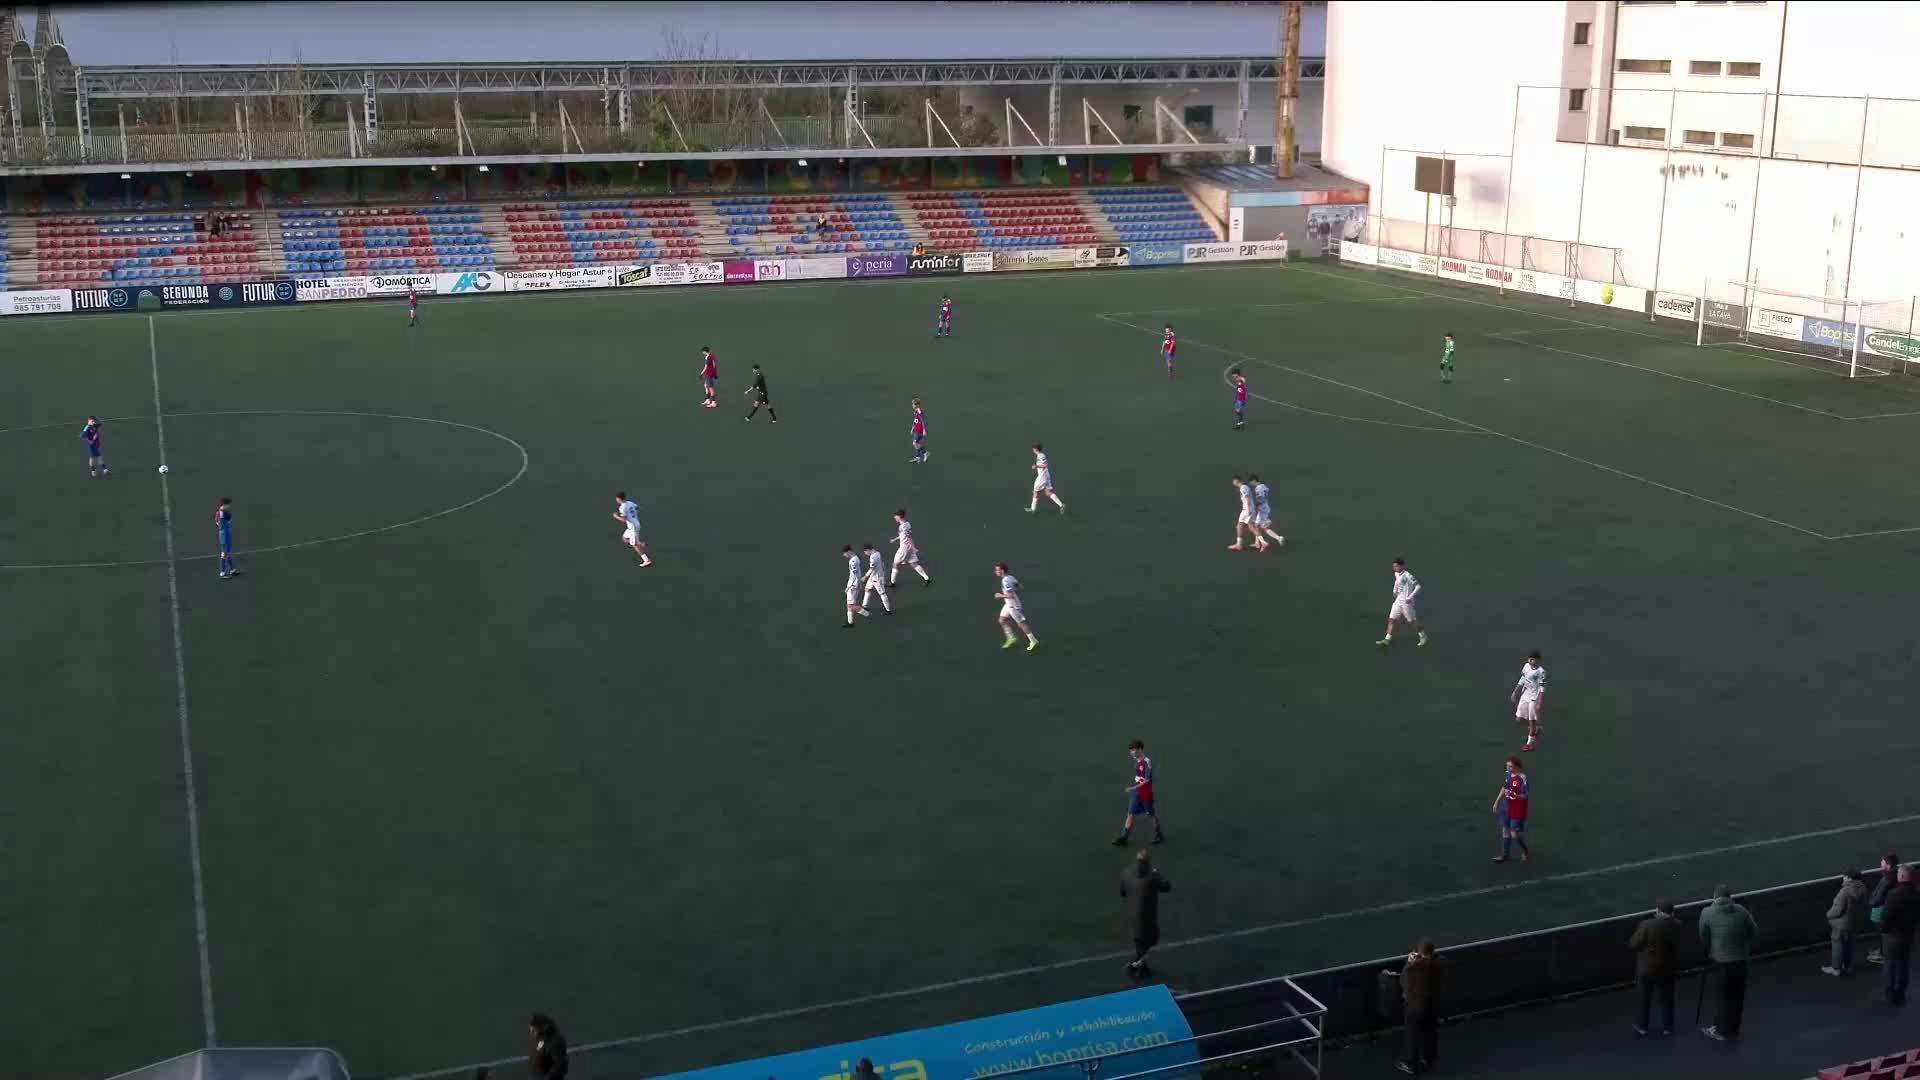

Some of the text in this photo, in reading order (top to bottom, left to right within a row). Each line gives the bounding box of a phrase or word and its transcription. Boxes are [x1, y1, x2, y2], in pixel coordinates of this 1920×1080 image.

[910, 255, 960, 270] suminfor
[1441, 260, 1467, 274] RODMAN
[507, 272, 547, 280] Descanso
[555, 269, 580, 279] Hogar
[583, 268, 605, 276] Astur
[297, 279, 331, 289] HOTEL
[13, 295, 61, 303] Petroasturias
[163, 286, 209, 300] SEGUNDA
[14, 304, 30, 312] 985
[1658, 299, 1692, 314] cadenas
[1772, 314, 1793, 324] FISECO
[963, 1011, 1157, 1055] Construcción y rehabilitación
